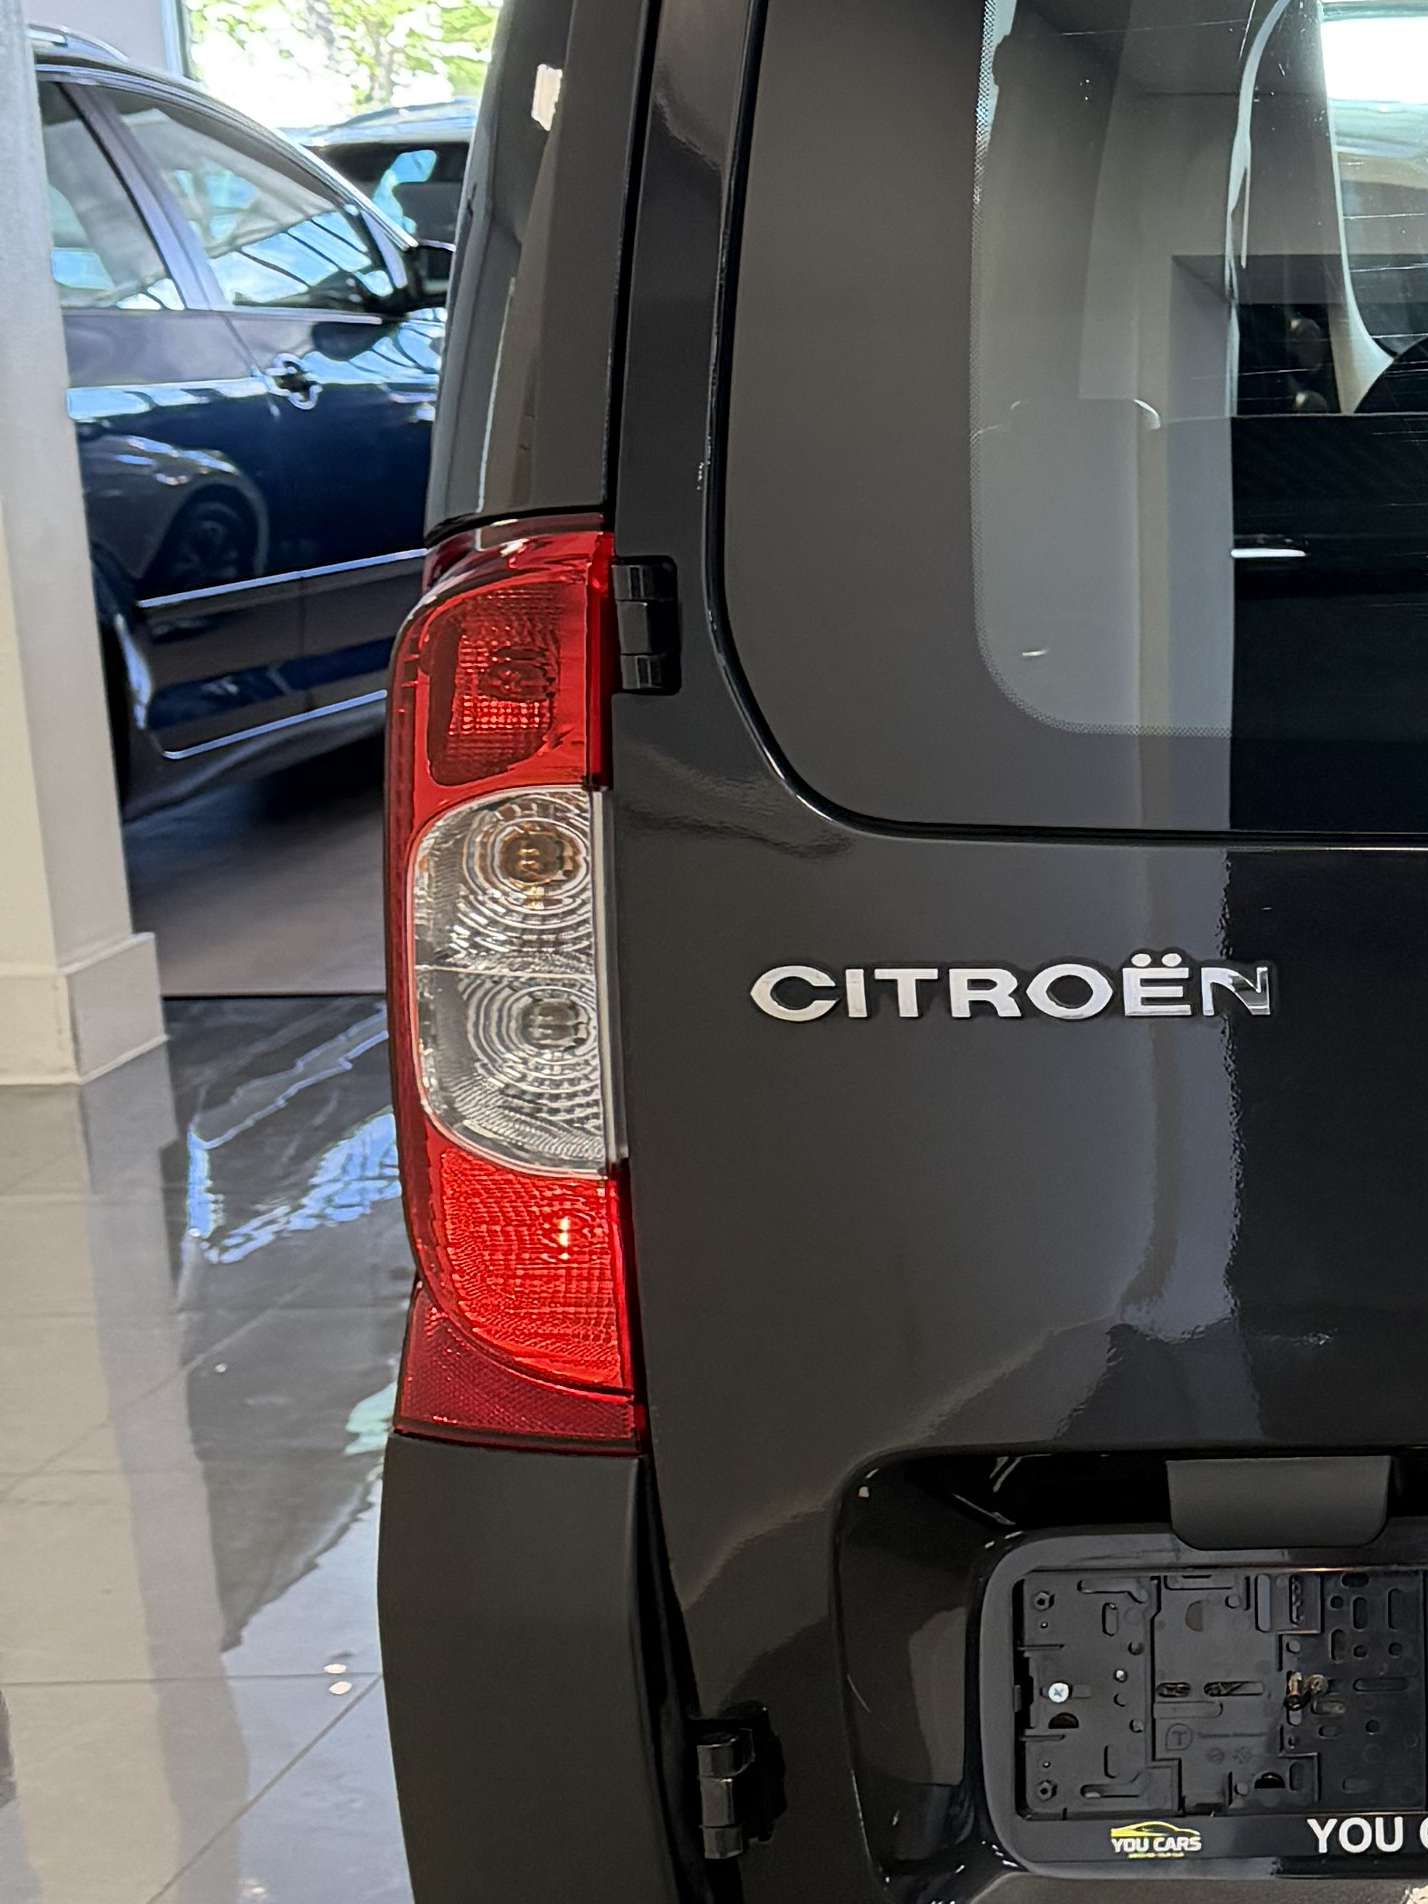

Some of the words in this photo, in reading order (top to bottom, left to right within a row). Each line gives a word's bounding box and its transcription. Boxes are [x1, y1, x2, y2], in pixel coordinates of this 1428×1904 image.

[749, 952, 1272, 1022] CITROËN
[1110, 1836, 1150, 1853] YOU
[1152, 1836, 1202, 1852] CARS
[1306, 1815, 1405, 1854] YOU
